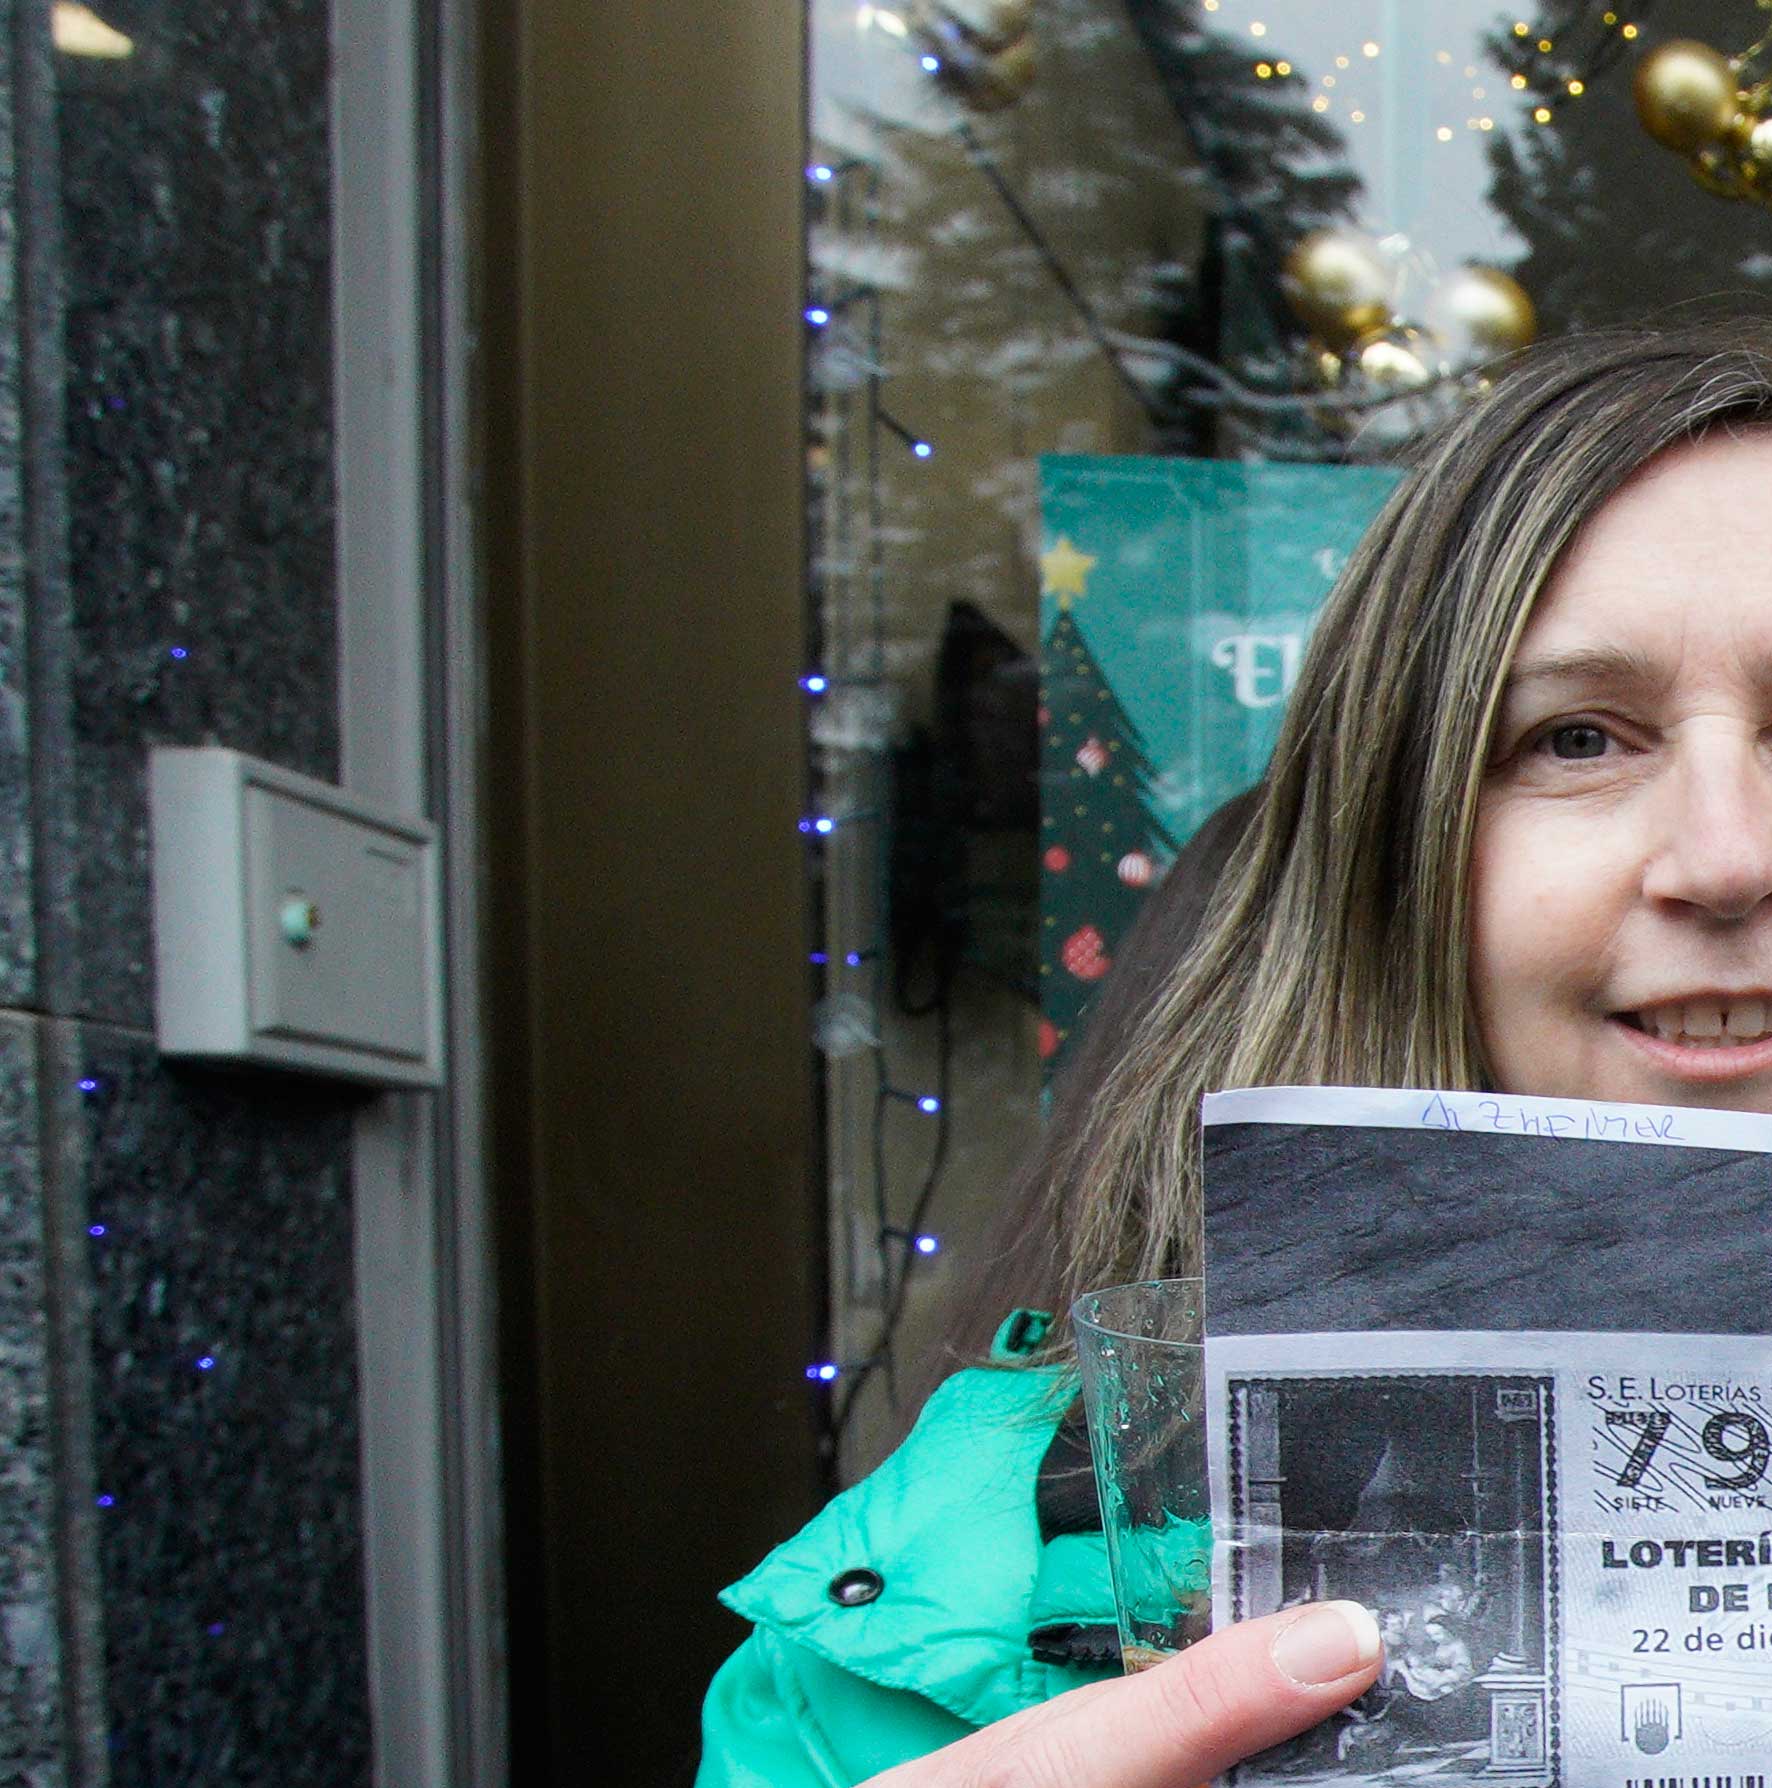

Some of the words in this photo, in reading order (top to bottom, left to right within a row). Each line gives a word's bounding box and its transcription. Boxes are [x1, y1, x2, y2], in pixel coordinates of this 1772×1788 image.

[1650, 1376, 1763, 1403] LOTERÍAS
[1612, 1495, 1666, 1512] SIETE
[1708, 1494, 1767, 1510] NUEVE
[1688, 1583, 1751, 1614] DE
[1631, 1627, 1671, 1654] 22
[1683, 1625, 1724, 1652] de
